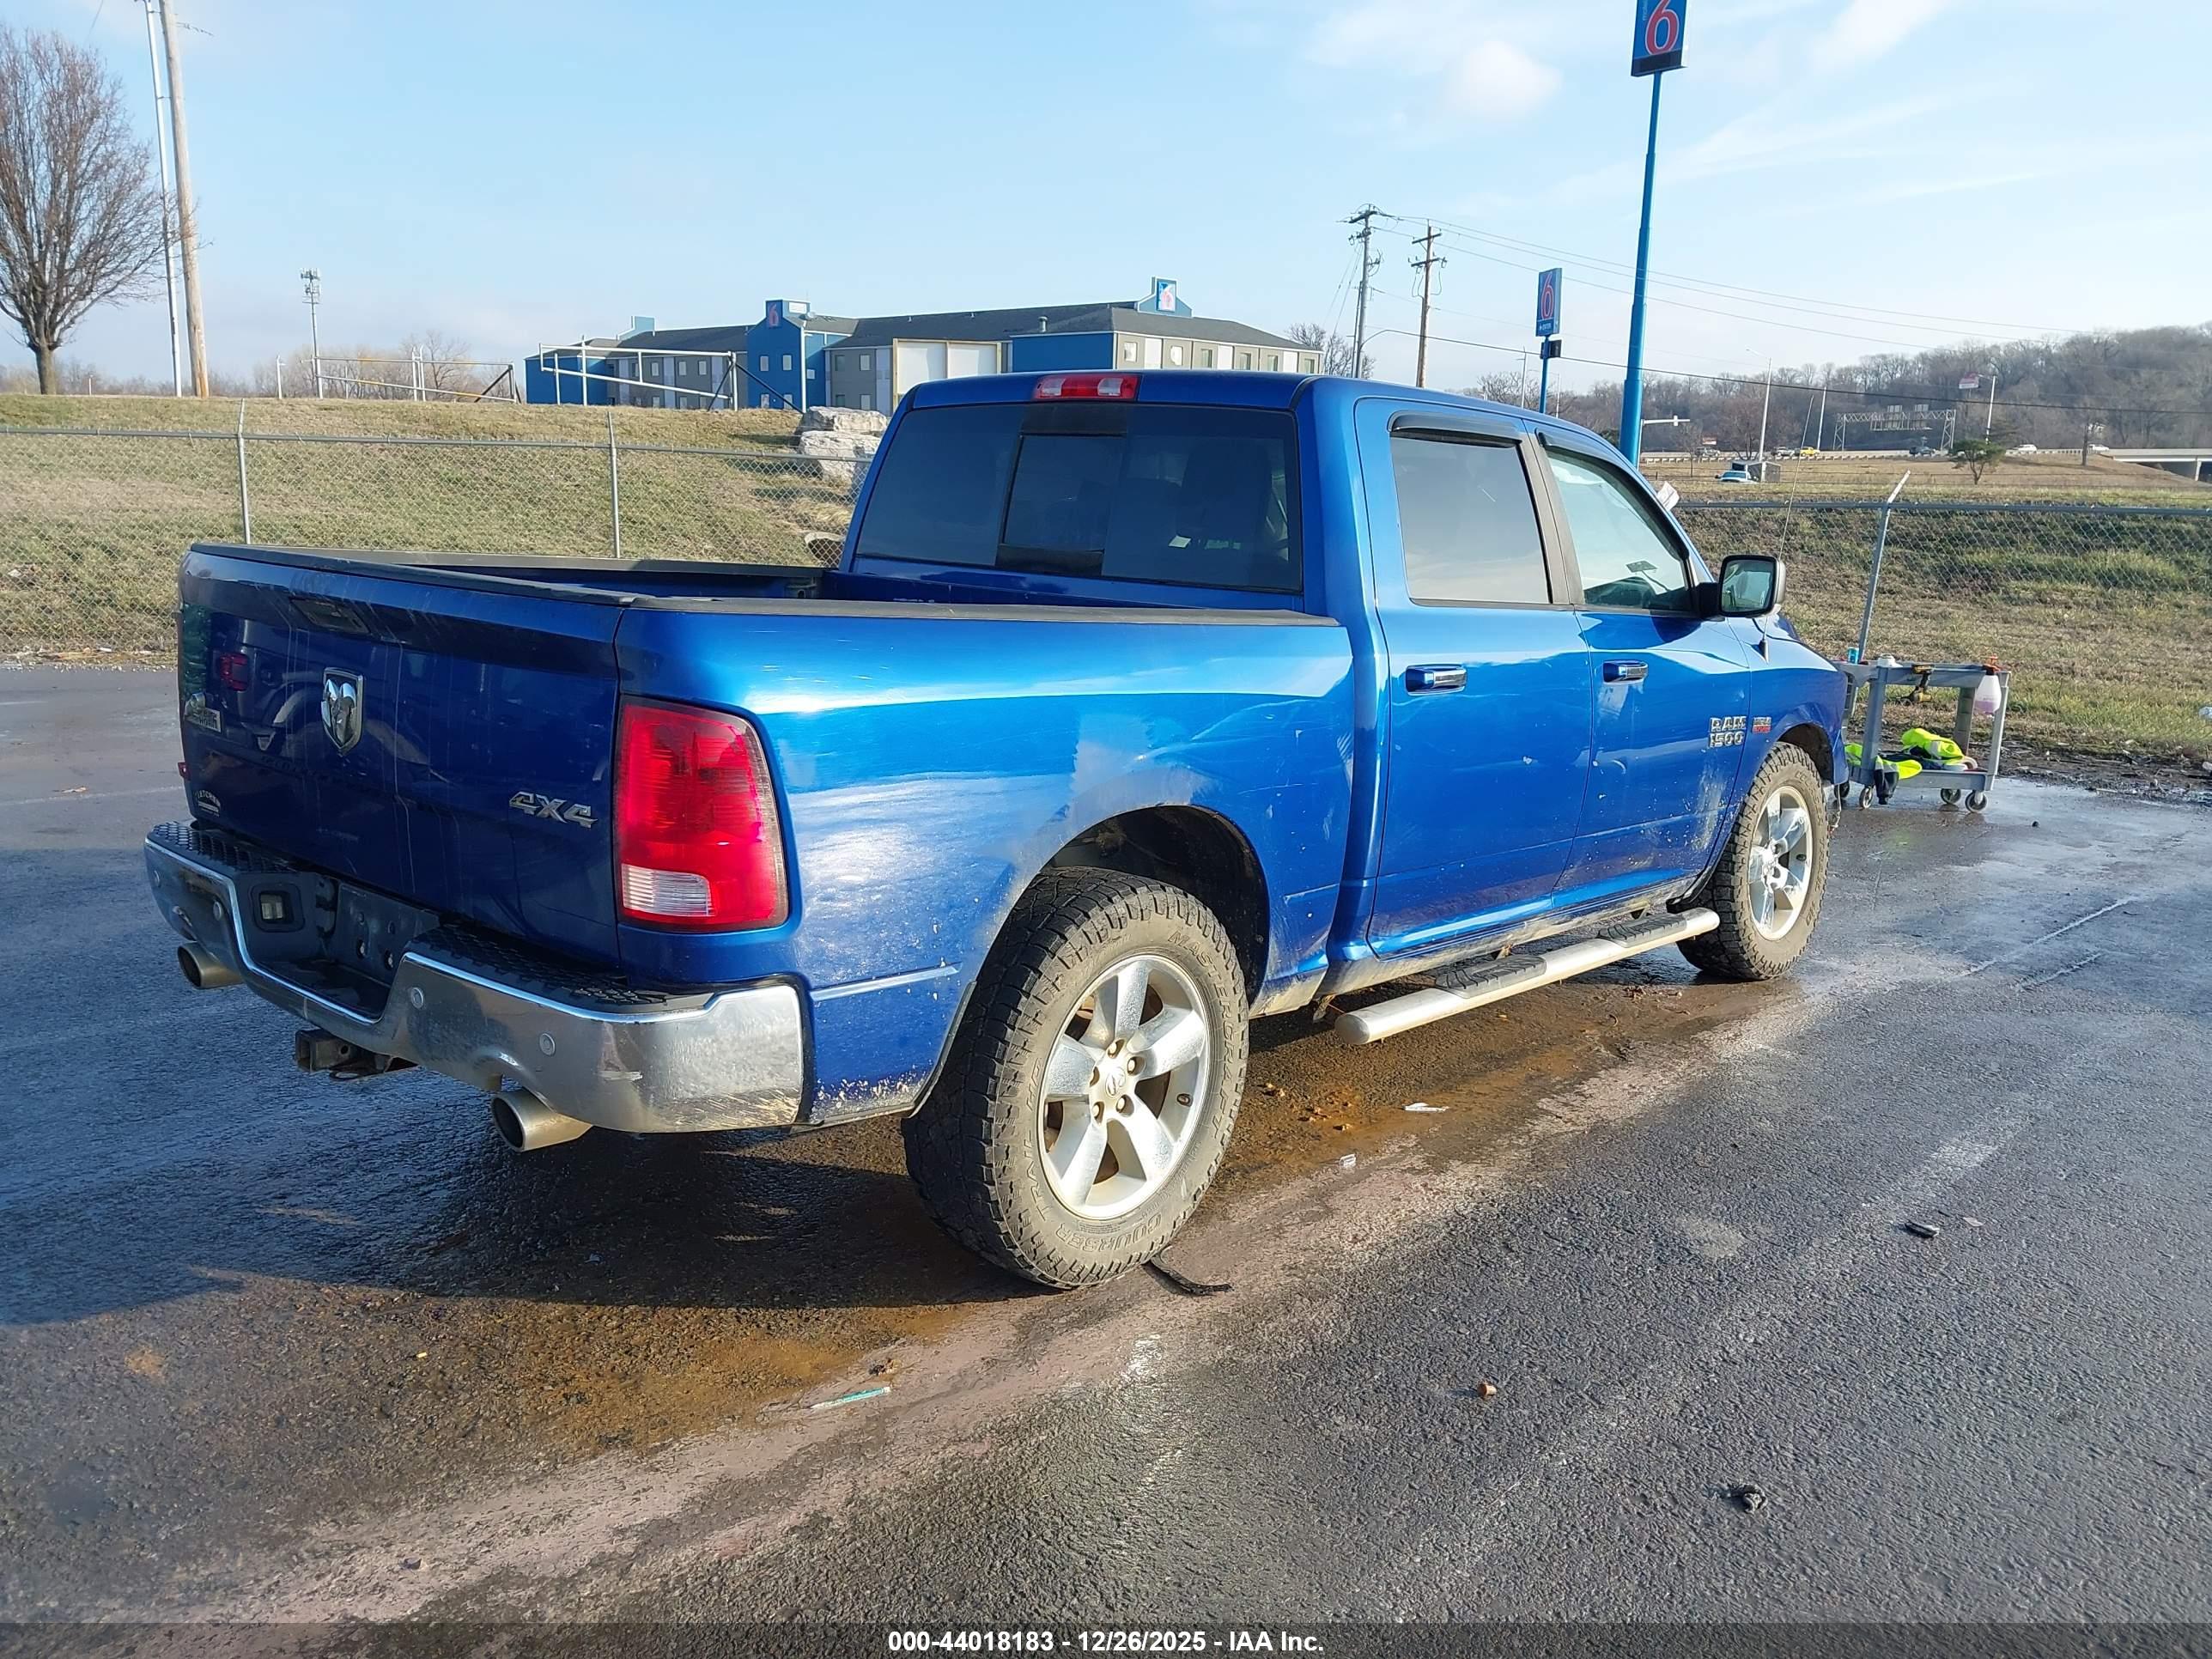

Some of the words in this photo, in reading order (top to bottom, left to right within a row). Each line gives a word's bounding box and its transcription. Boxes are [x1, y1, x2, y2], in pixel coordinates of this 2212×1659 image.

[1645, 0, 1680, 55] 6
[1540, 271, 1553, 320] 6
[1709, 731, 1745, 748] 1500
[1710, 716, 1747, 732] RAM
[1167, 927, 1235, 1139] MASTERCRAFT
[1024, 1129, 1052, 1222] TRAIL
[1055, 1212, 1162, 1253] COURSER
